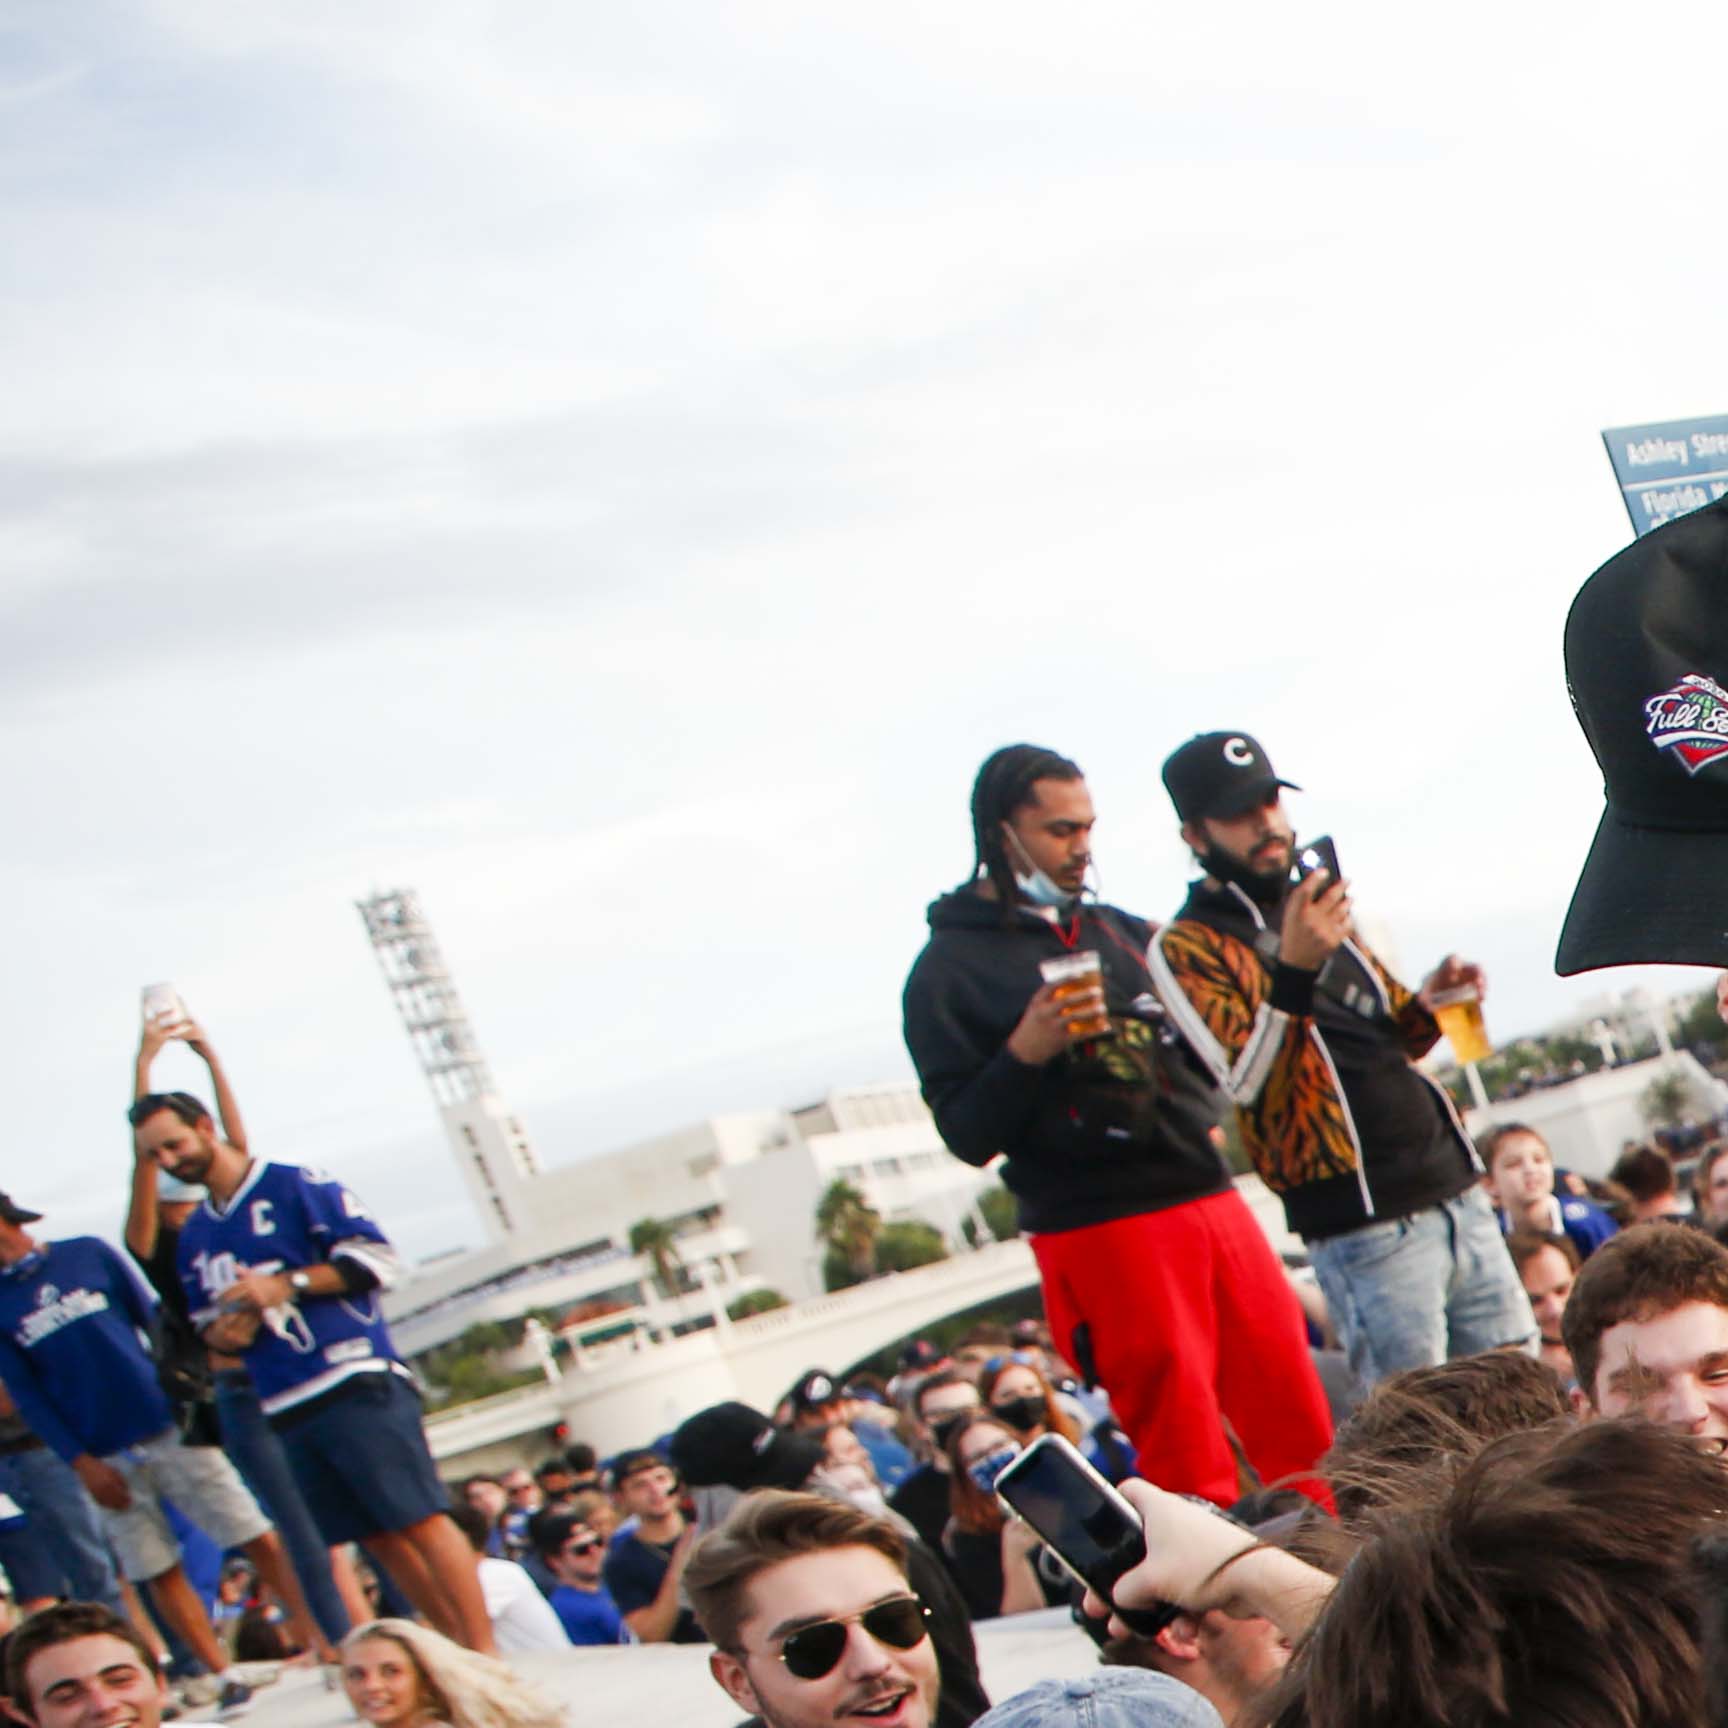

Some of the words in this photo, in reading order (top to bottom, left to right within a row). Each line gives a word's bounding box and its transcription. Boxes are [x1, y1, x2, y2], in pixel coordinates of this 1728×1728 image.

[1626, 438, 1689, 467] Ashley
[1641, 486, 1708, 514] Florida
[1646, 693, 1701, 734] Full
[1223, 737, 1255, 766] C
[251, 1199, 276, 1237] C
